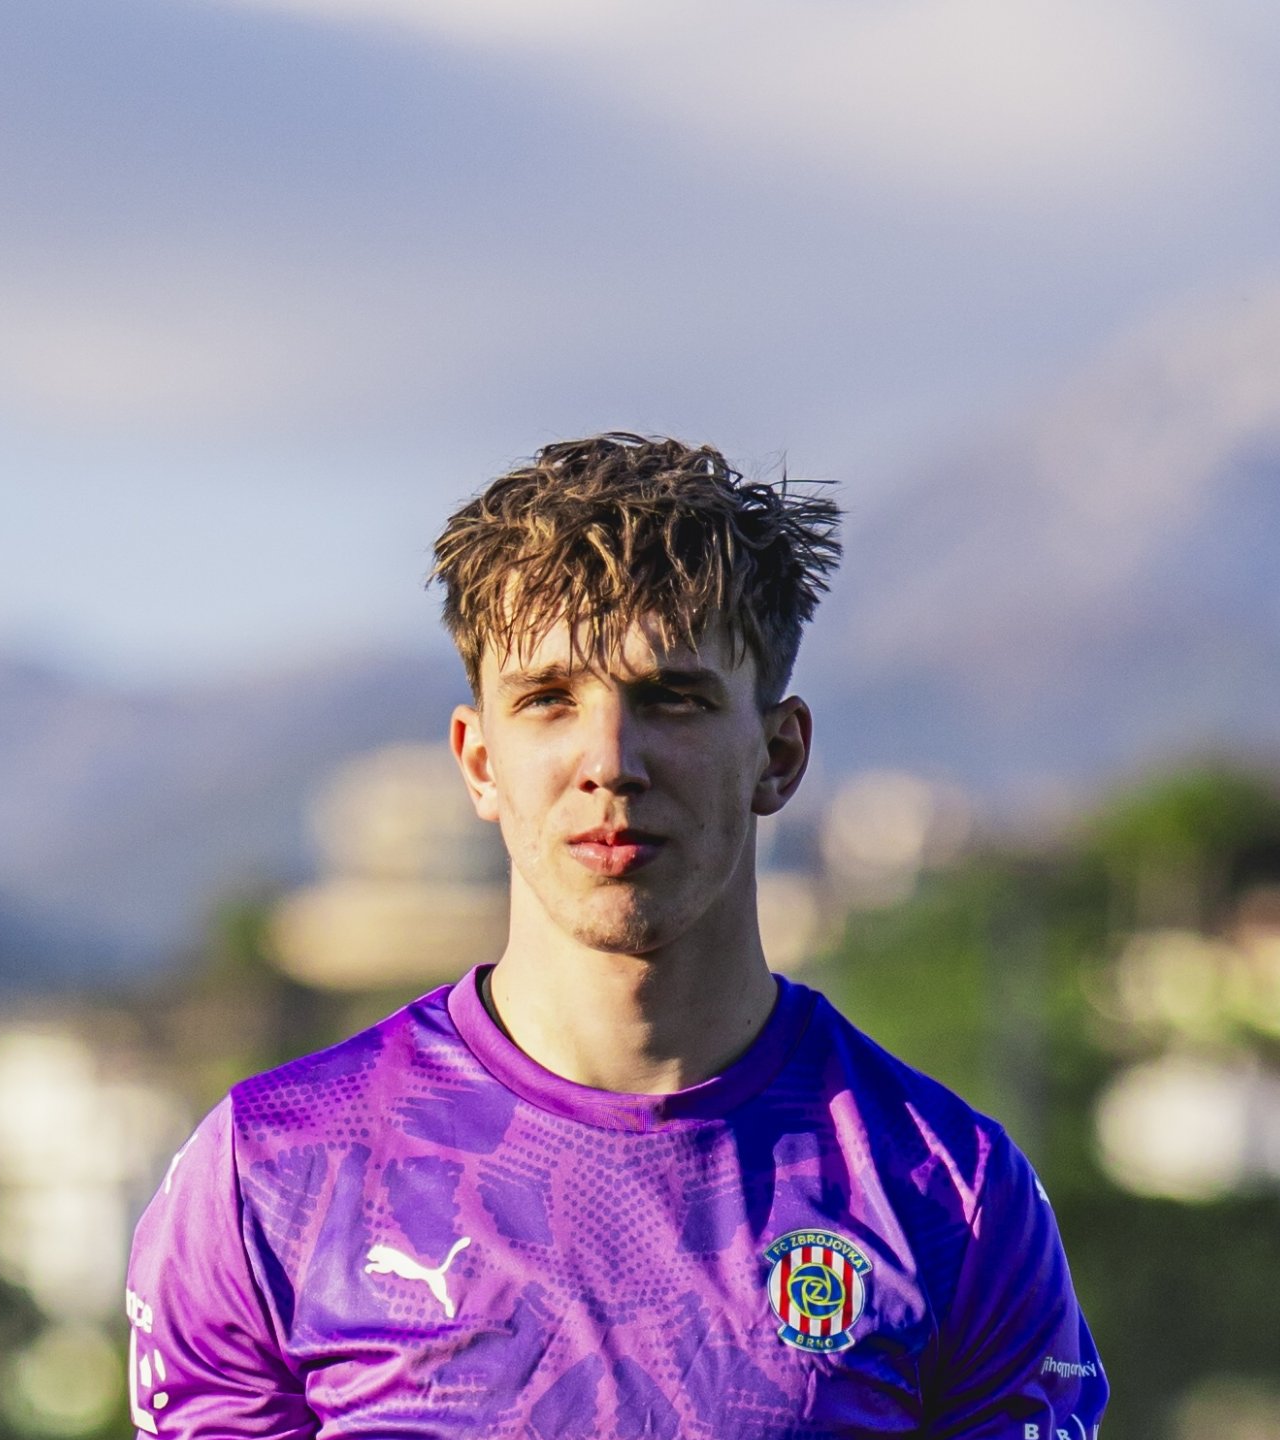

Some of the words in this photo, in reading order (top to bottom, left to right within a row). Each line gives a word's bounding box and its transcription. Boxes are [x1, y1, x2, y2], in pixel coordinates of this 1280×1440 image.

[773, 1242, 788, 1256] FC
[789, 1234, 863, 1269] ZBROJOVKA
[795, 1334, 834, 1348] BRNO
